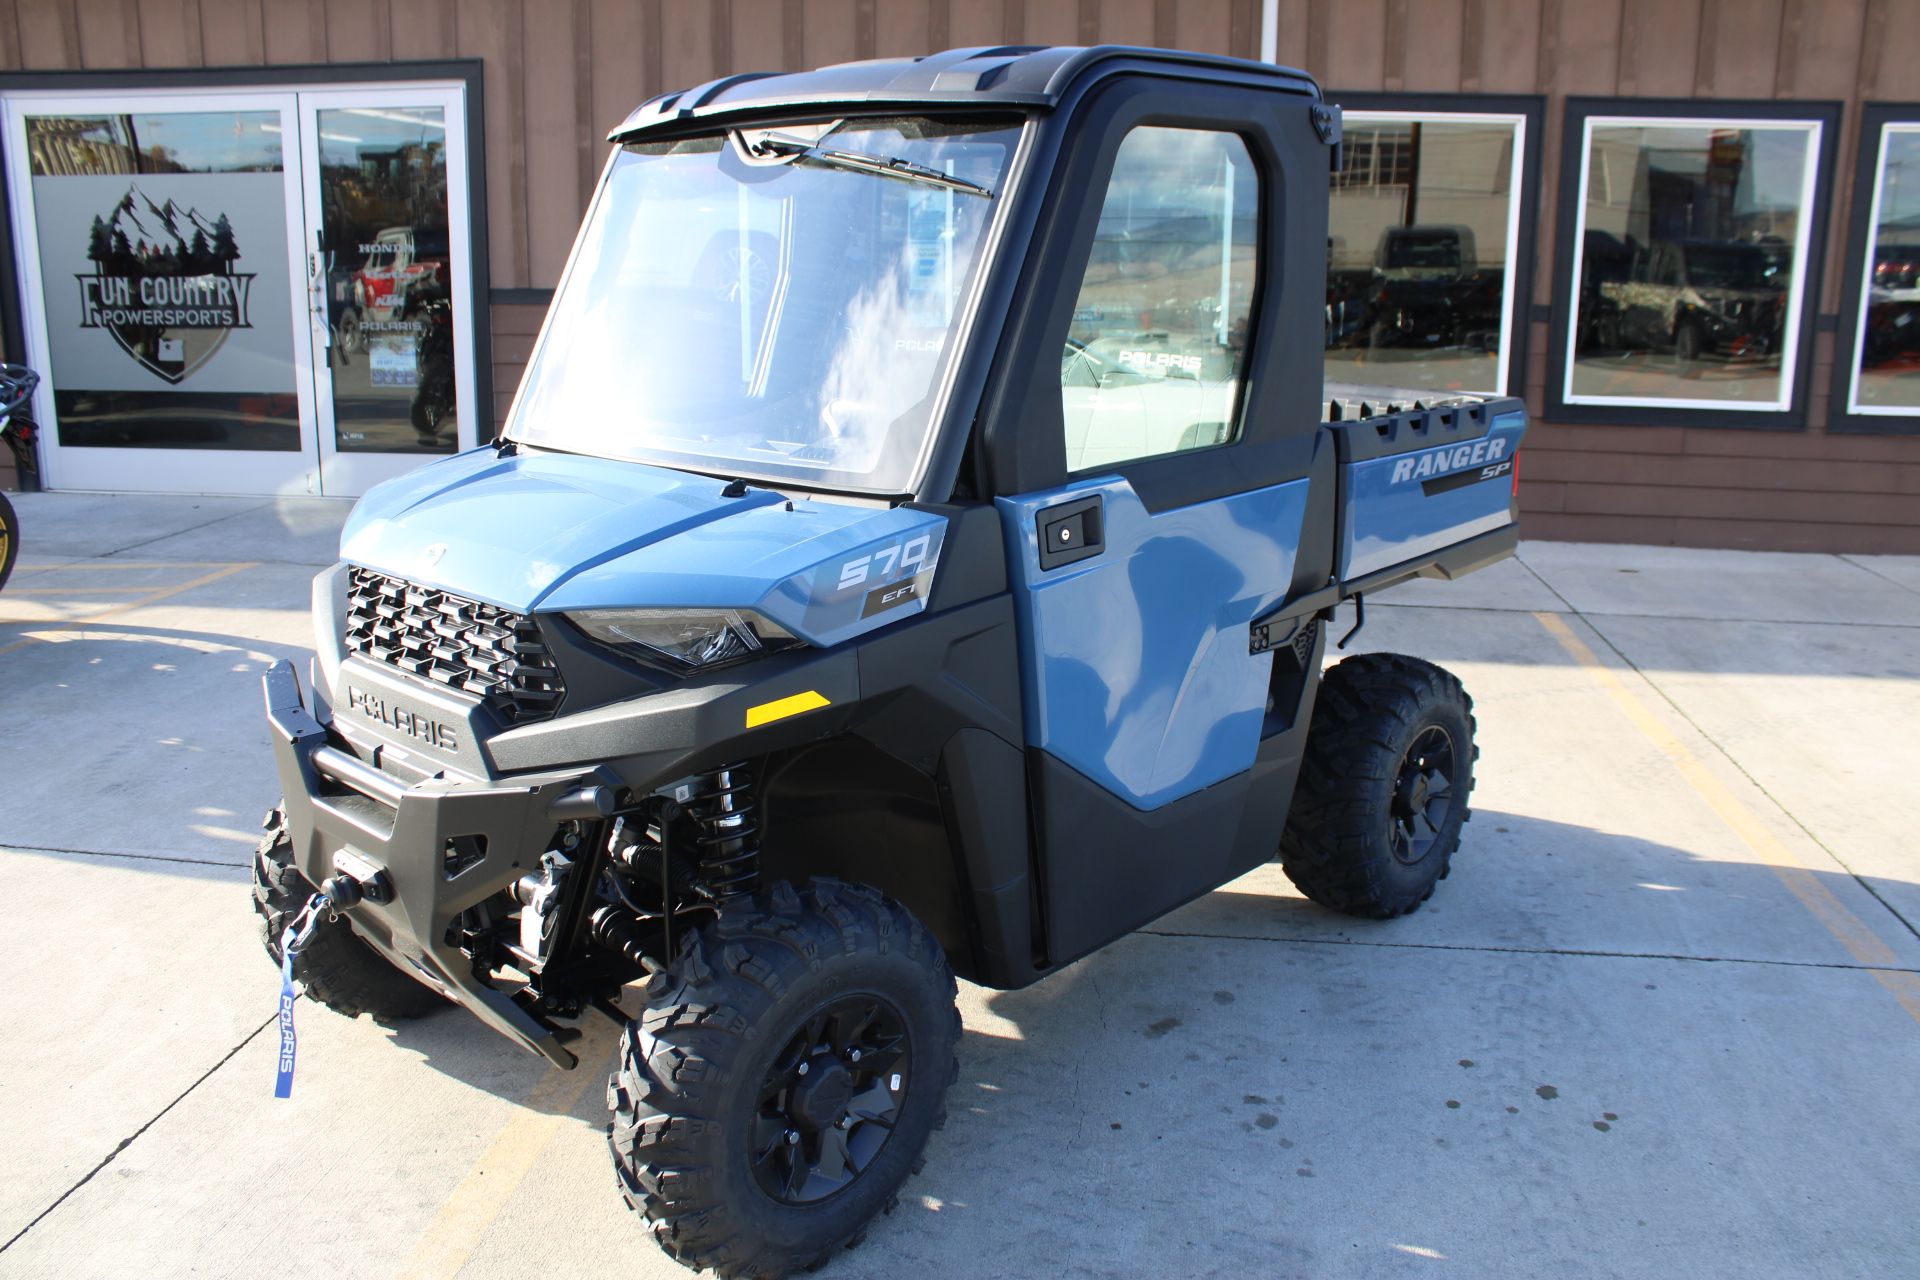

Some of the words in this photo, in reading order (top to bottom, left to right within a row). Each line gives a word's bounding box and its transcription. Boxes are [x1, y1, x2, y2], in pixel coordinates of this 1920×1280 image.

[358, 243, 414, 254] HONDA
[79, 276, 132, 326] FUN
[140, 274, 252, 326] COUNTRY
[102, 309, 233, 326] POWERSPORTS
[360, 321, 422, 332] POLARIS
[1118, 351, 1202, 370] POLARIS
[1390, 438, 1506, 484] RANGER
[1480, 462, 1511, 479] SP
[837, 534, 931, 591] 570
[881, 583, 916, 604] EFI
[348, 685, 459, 754] POLARIS
[280, 994, 295, 1073] POLARIS
